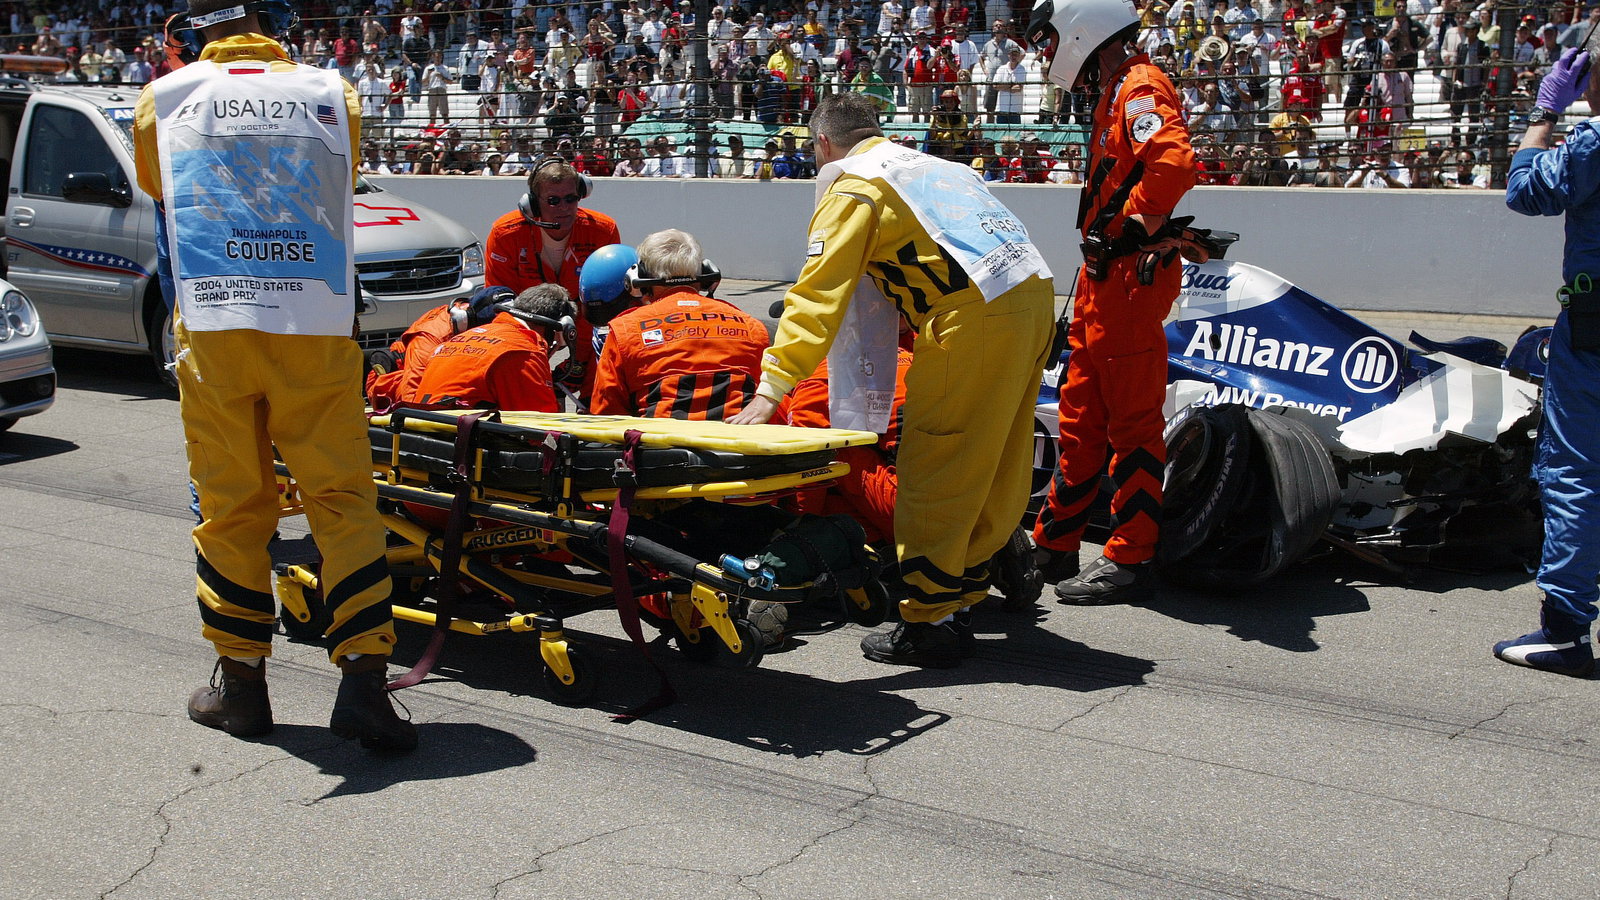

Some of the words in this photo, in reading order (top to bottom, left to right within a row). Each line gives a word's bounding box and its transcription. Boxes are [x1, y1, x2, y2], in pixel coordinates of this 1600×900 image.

[214, 99, 309, 119] USA1271
[231, 228, 307, 240] INDIANAPOLIS
[981, 218, 1022, 235] CURSE
[226, 240, 315, 262] COURSE
[194, 281, 222, 292] 2004
[225, 280, 261, 290] UNITED
[263, 282, 303, 292] STATES
[1181, 263, 1242, 291] Bud
[194, 291, 230, 303] GRAND
[232, 291, 257, 301] PRIX
[640, 312, 746, 331] DELPHI
[449, 335, 502, 345] ELPHI
[664, 325, 711, 342] Safety
[716, 325, 749, 337] Team
[1183, 320, 1335, 377] Allianz
[473, 526, 537, 549] RUGGED
